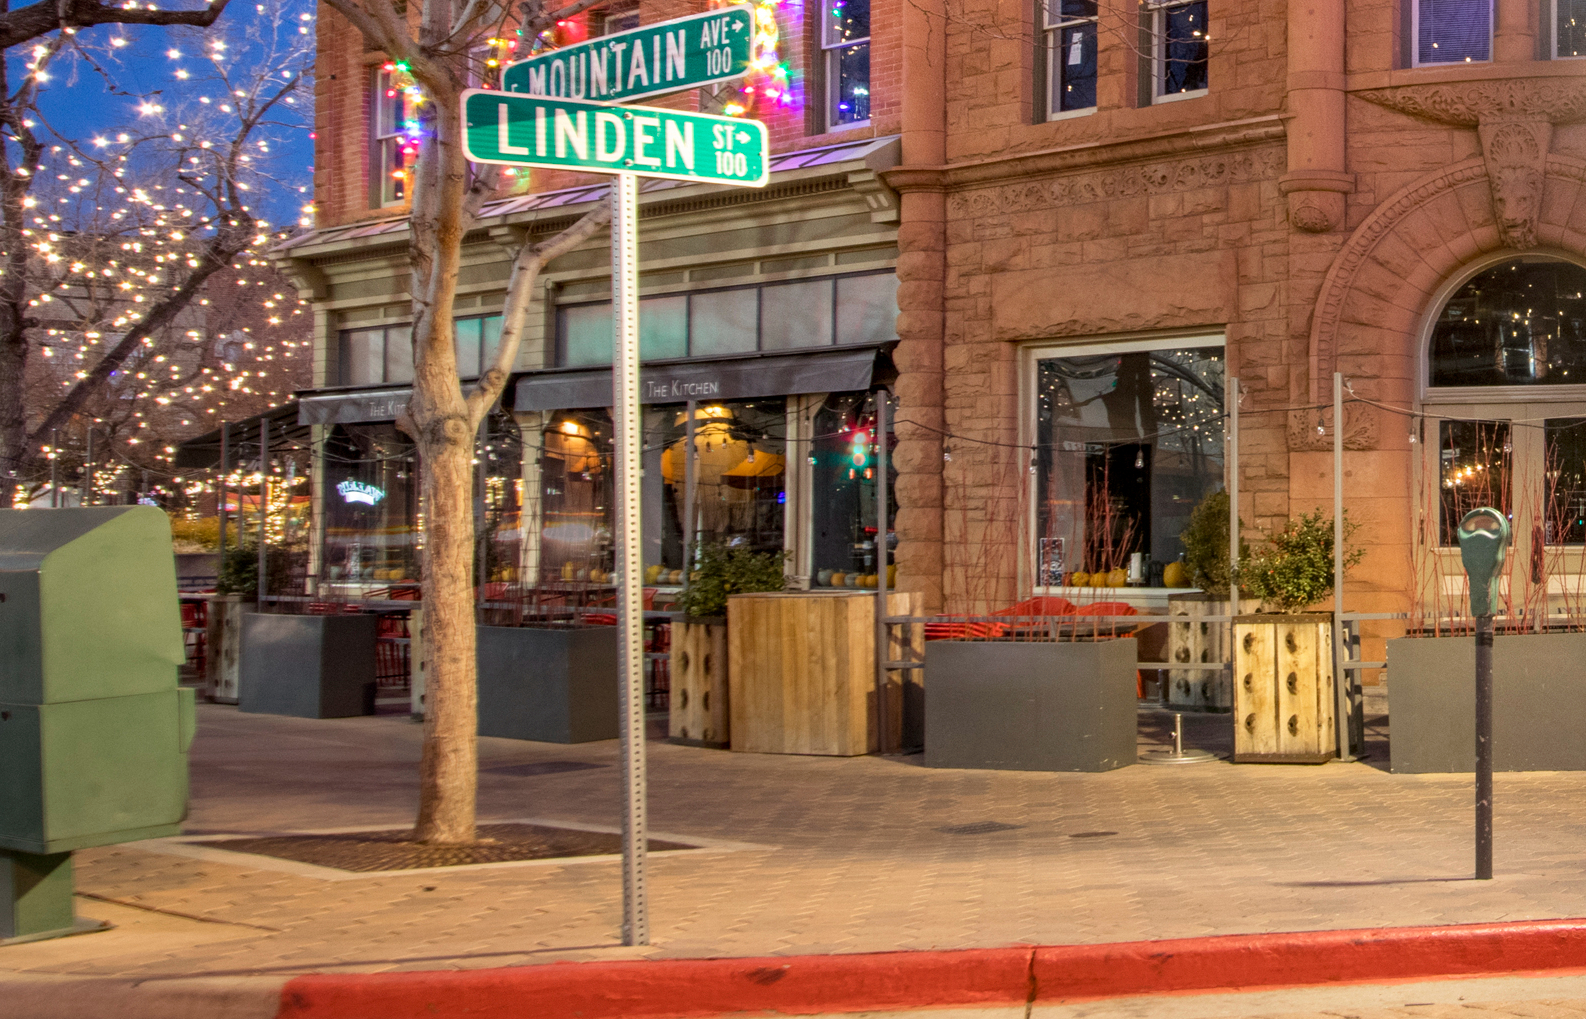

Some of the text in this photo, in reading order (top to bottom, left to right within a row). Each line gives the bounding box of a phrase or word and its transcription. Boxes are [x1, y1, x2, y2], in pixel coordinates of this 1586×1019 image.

[529, 16, 730, 100] MOUNTAIN AVE
[706, 46, 732, 77] 100
[498, 102, 736, 170] LINDEN ST
[715, 150, 747, 177] 100
[671, 379, 719, 397] KITCHEN
